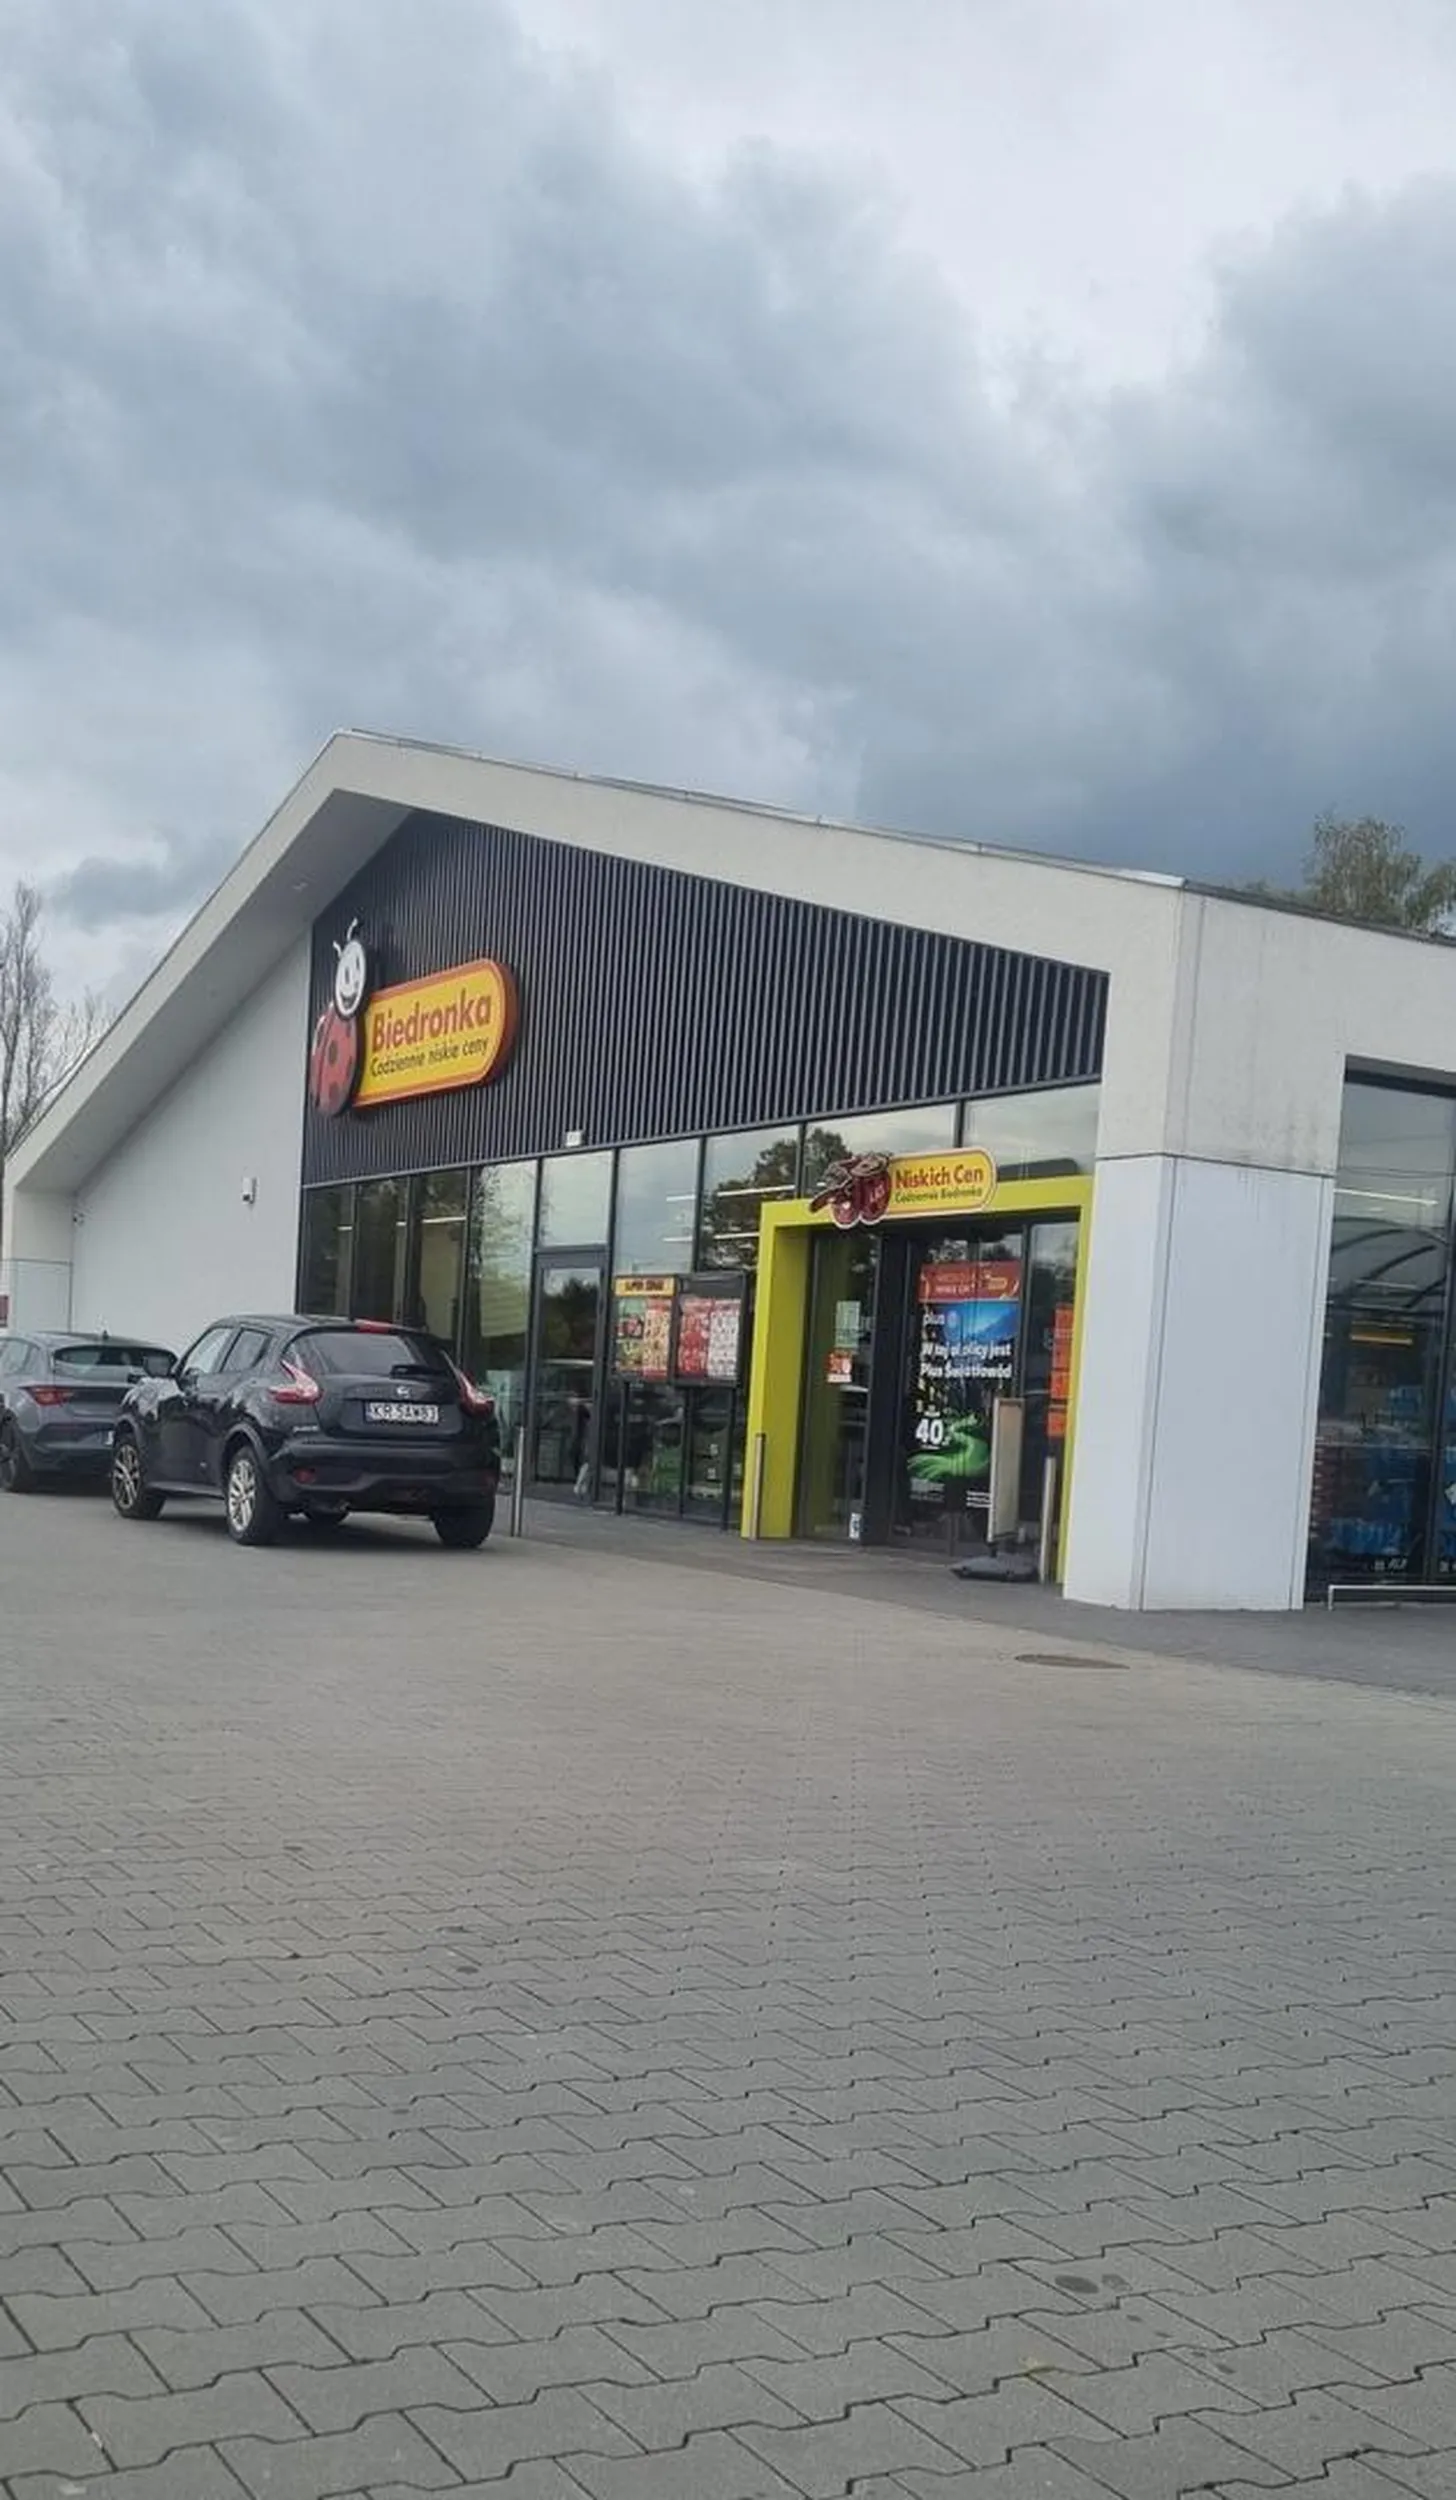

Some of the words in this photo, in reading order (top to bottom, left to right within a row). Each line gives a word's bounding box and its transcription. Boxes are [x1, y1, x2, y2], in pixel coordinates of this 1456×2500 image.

[372, 988, 492, 1052] Biedronka
[428, 1040, 459, 1066] niskie
[462, 1036, 488, 1057] ceny
[896, 1166, 950, 1188] Niskich
[954, 1164, 983, 1184] Cen
[920, 1363, 943, 1377] Plus
[915, 1418, 943, 1445] 40
